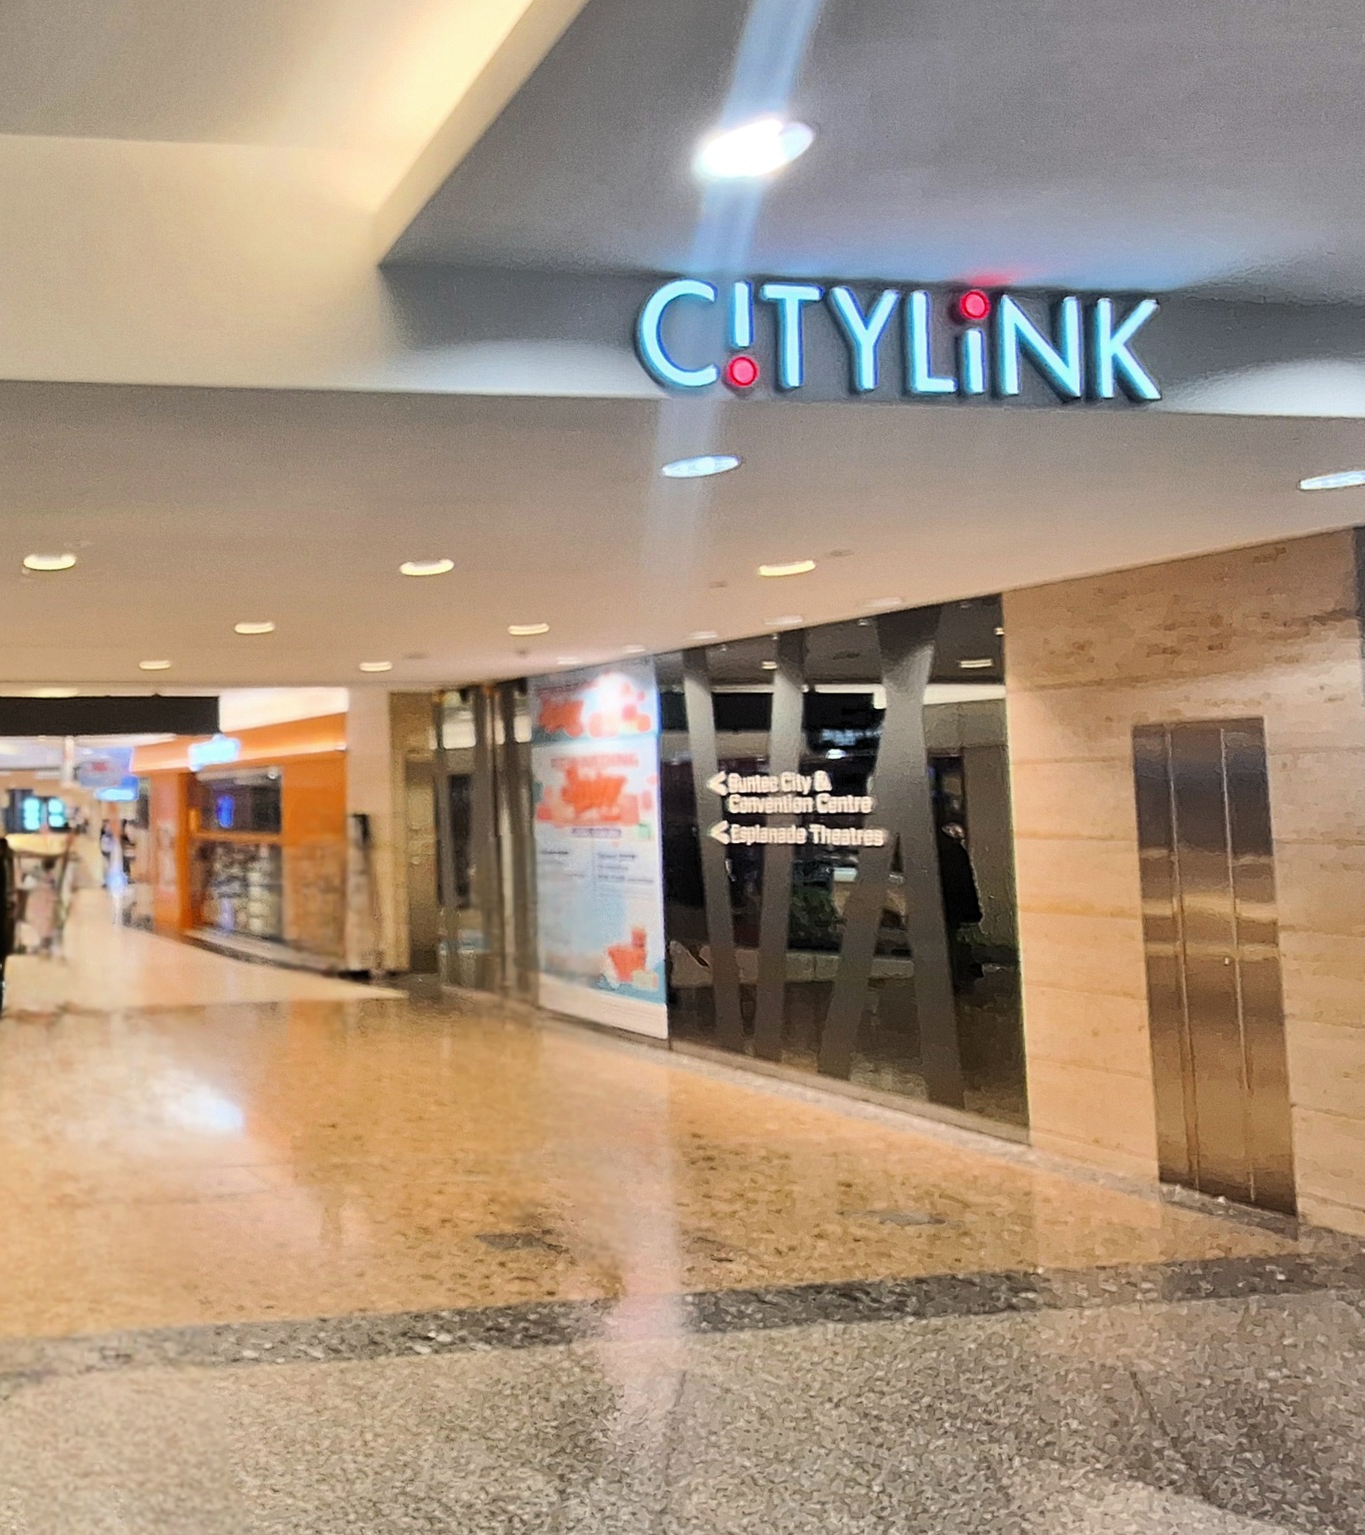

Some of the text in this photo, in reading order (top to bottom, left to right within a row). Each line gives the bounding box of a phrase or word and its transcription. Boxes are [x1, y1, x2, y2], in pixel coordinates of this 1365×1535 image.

[727, 773, 779, 793] Suntec
[781, 772, 812, 794] City
[728, 793, 873, 813] Convention Centre
[730, 824, 884, 847] Esplanade Theatres
